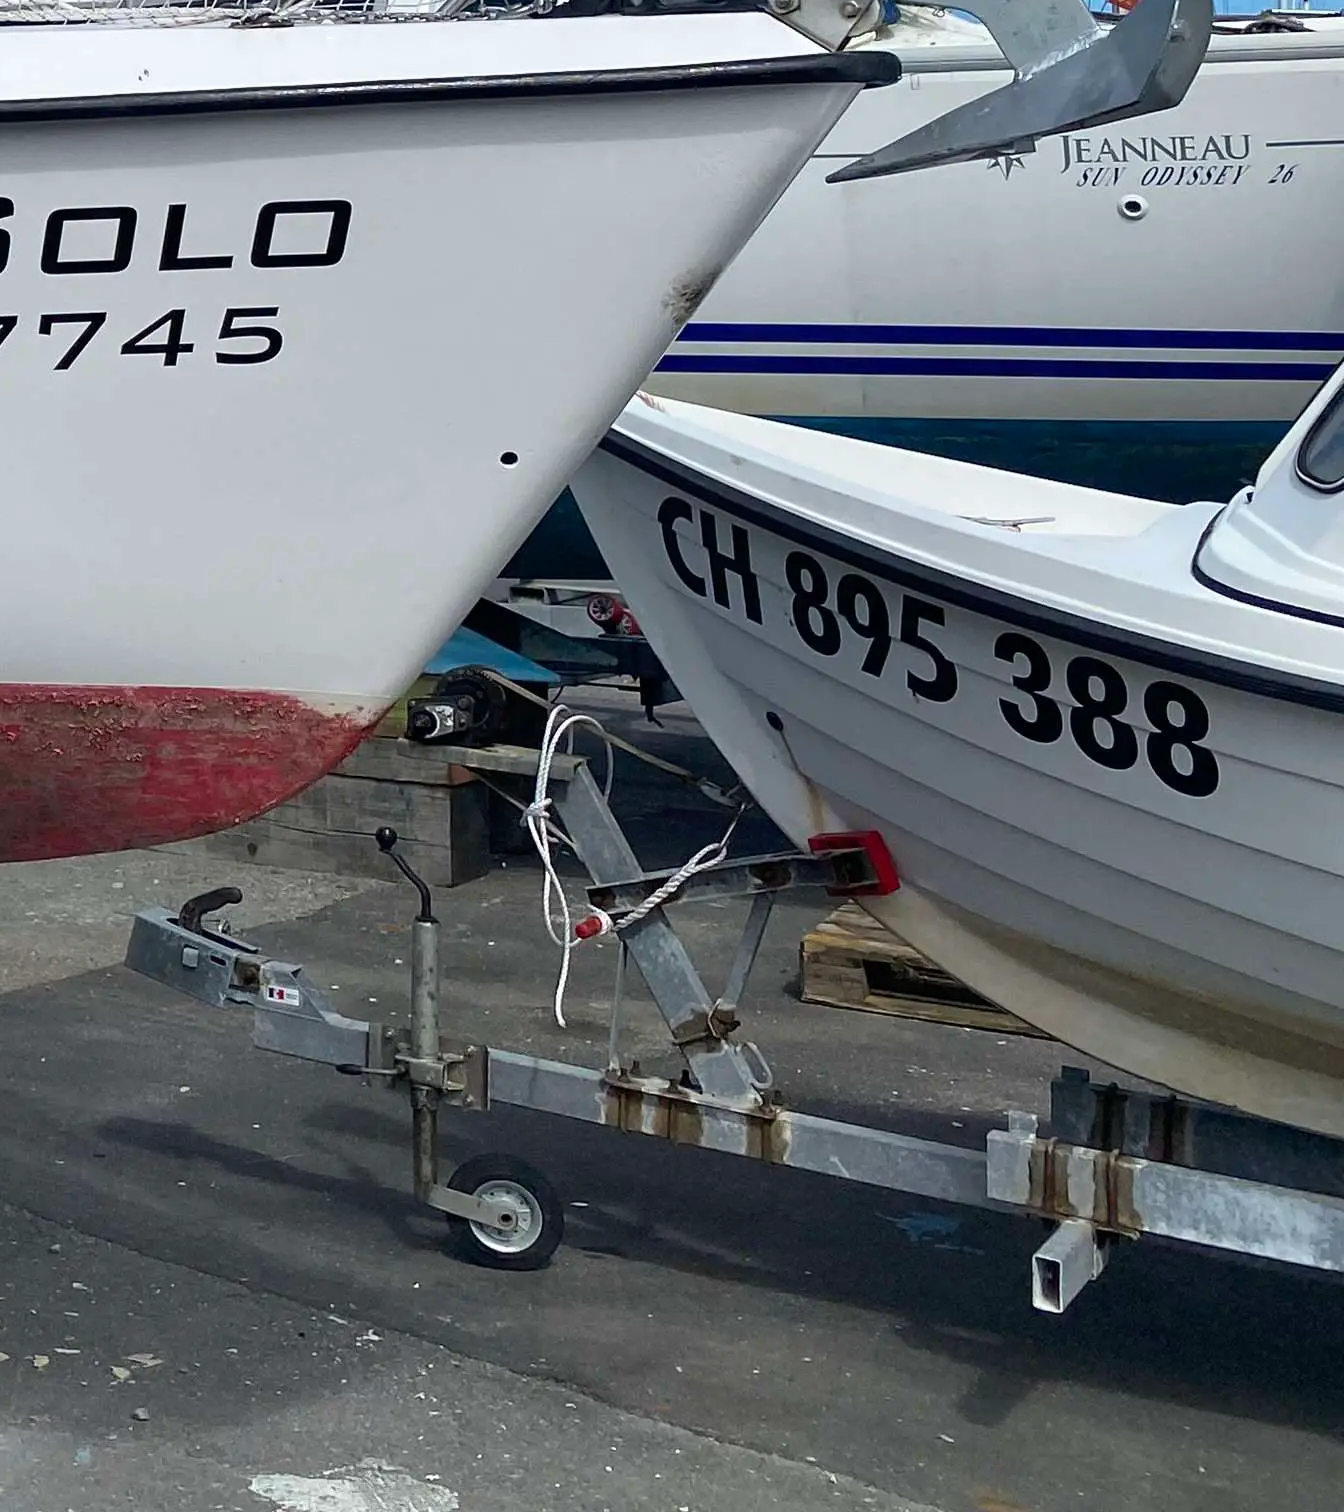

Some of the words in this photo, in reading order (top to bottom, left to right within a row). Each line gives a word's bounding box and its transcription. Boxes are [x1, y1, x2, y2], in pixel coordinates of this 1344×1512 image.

[1060, 134, 1251, 174] JEANNEAU
[1076, 166, 1127, 188] SUN
[1140, 164, 1253, 187] ODYSSEY
[1267, 162, 1301, 184] 26
[657, 496, 764, 626] CH
[785, 550, 959, 703] 895
[994, 631, 1219, 788] 388
